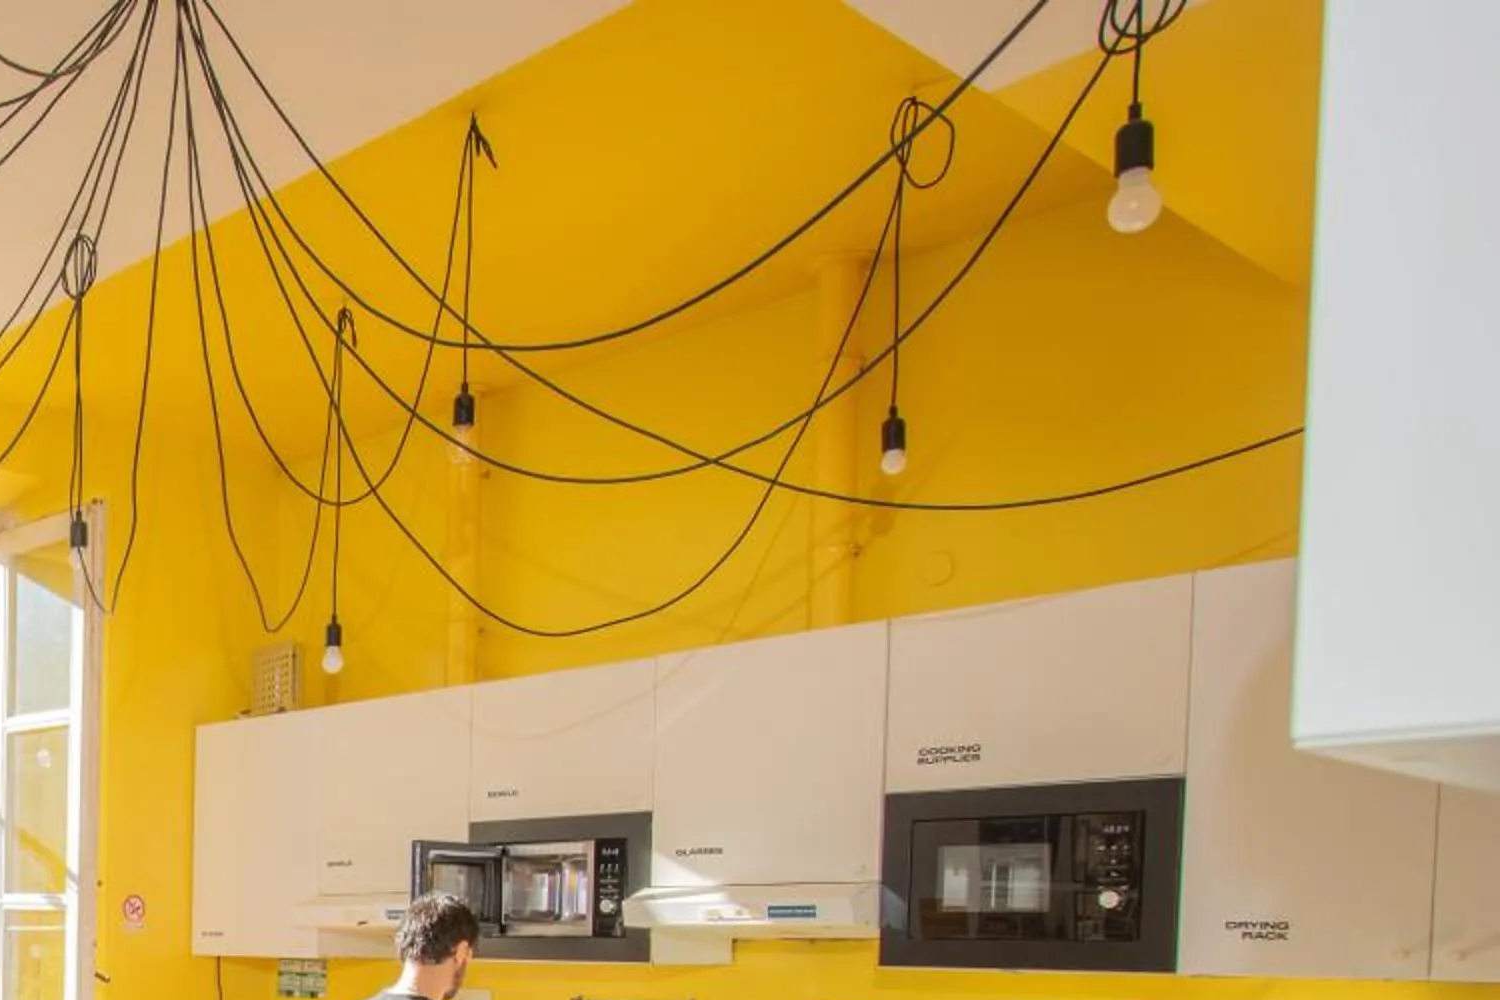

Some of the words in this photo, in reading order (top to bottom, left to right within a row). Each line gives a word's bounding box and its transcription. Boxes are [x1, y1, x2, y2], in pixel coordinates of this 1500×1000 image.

[918, 743, 981, 757] COOKING
[917, 753, 981, 766] SUPPLIES
[1225, 921, 1290, 931] DRYING
[1241, 931, 1290, 941] RACK
